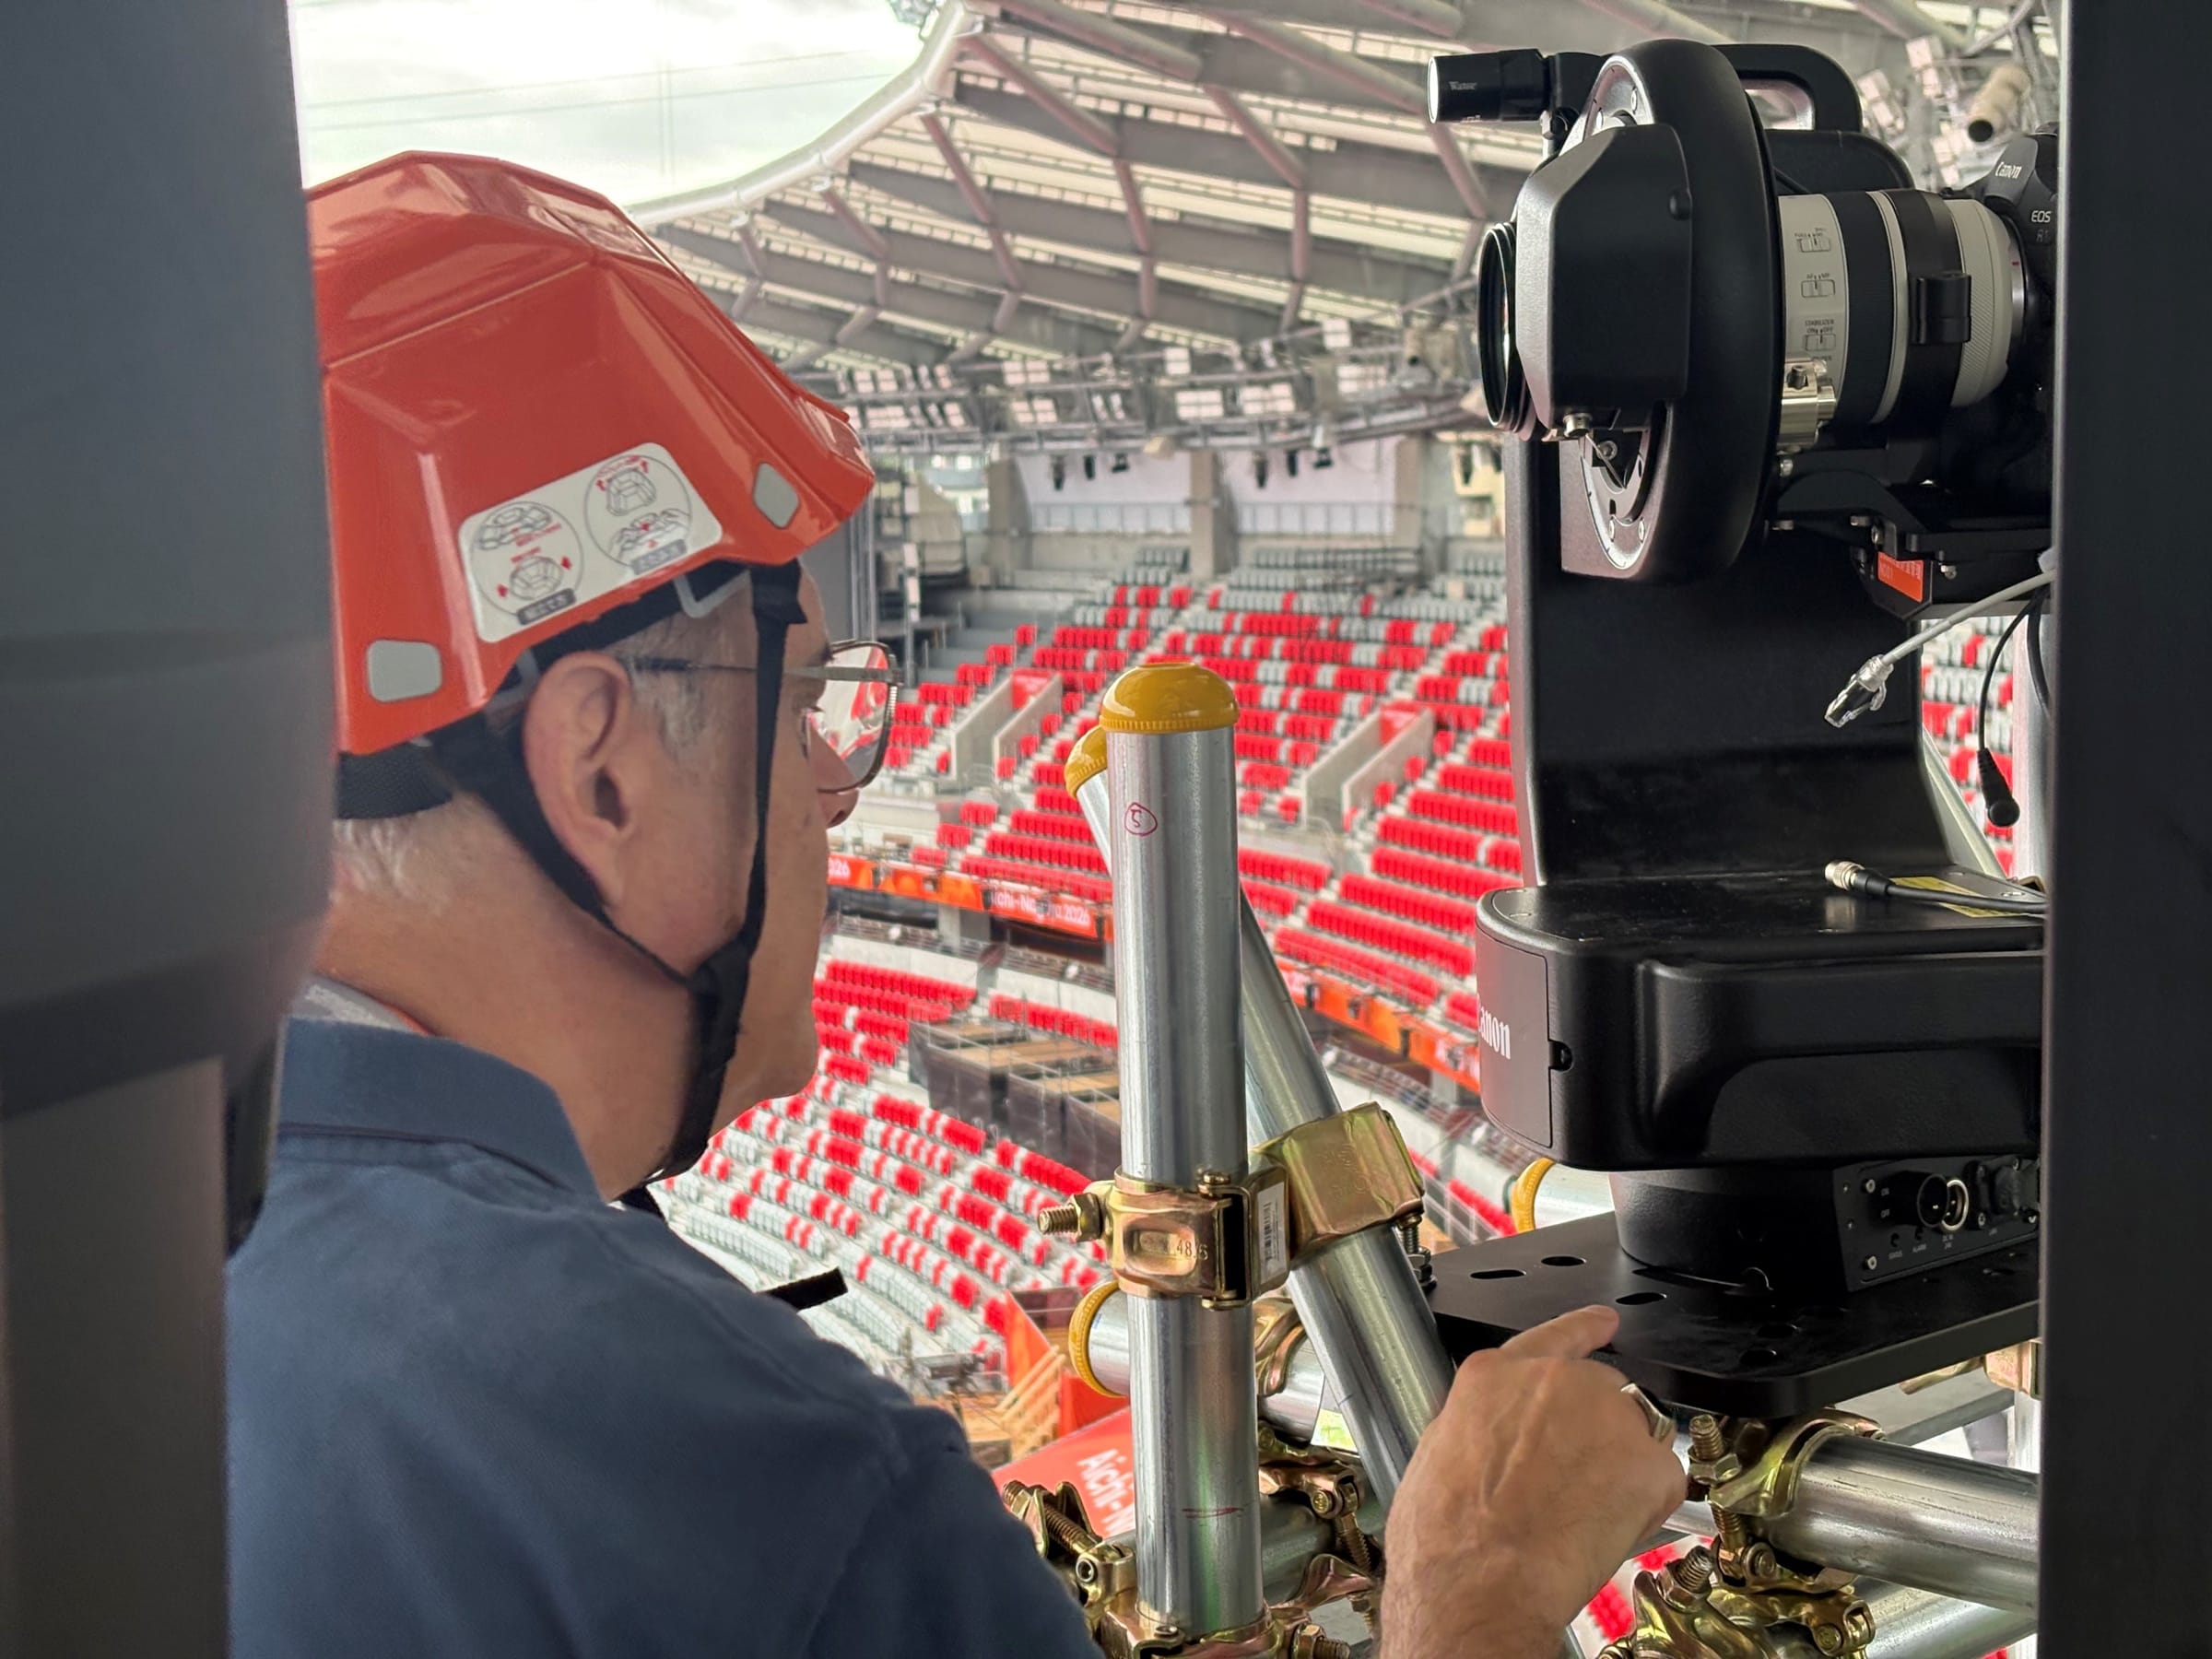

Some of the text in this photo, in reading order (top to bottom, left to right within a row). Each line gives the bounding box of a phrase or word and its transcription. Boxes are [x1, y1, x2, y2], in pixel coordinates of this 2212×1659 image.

[1994, 161, 2022, 179] Canon
[2030, 210, 2052, 223] EOS
[1063, 904, 1090, 927] 2026
